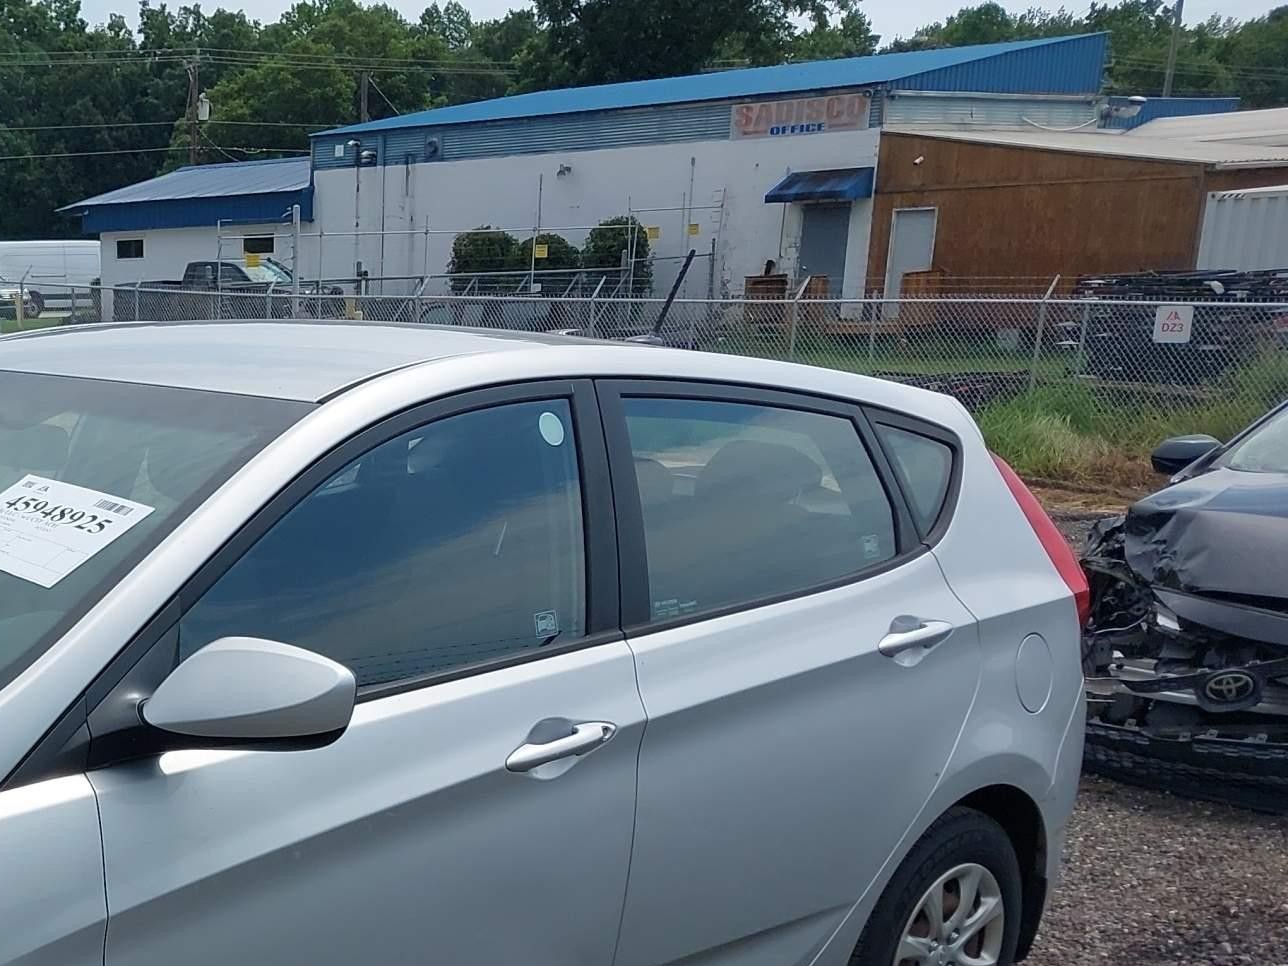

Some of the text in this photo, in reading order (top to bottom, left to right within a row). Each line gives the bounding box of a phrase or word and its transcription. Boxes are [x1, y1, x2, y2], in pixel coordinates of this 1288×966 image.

[739, 96, 866, 128] SADISCO
[769, 122, 825, 136] OFFICE
[1161, 322, 1184, 333] DZ3
[5, 495, 113, 534] 45948925
